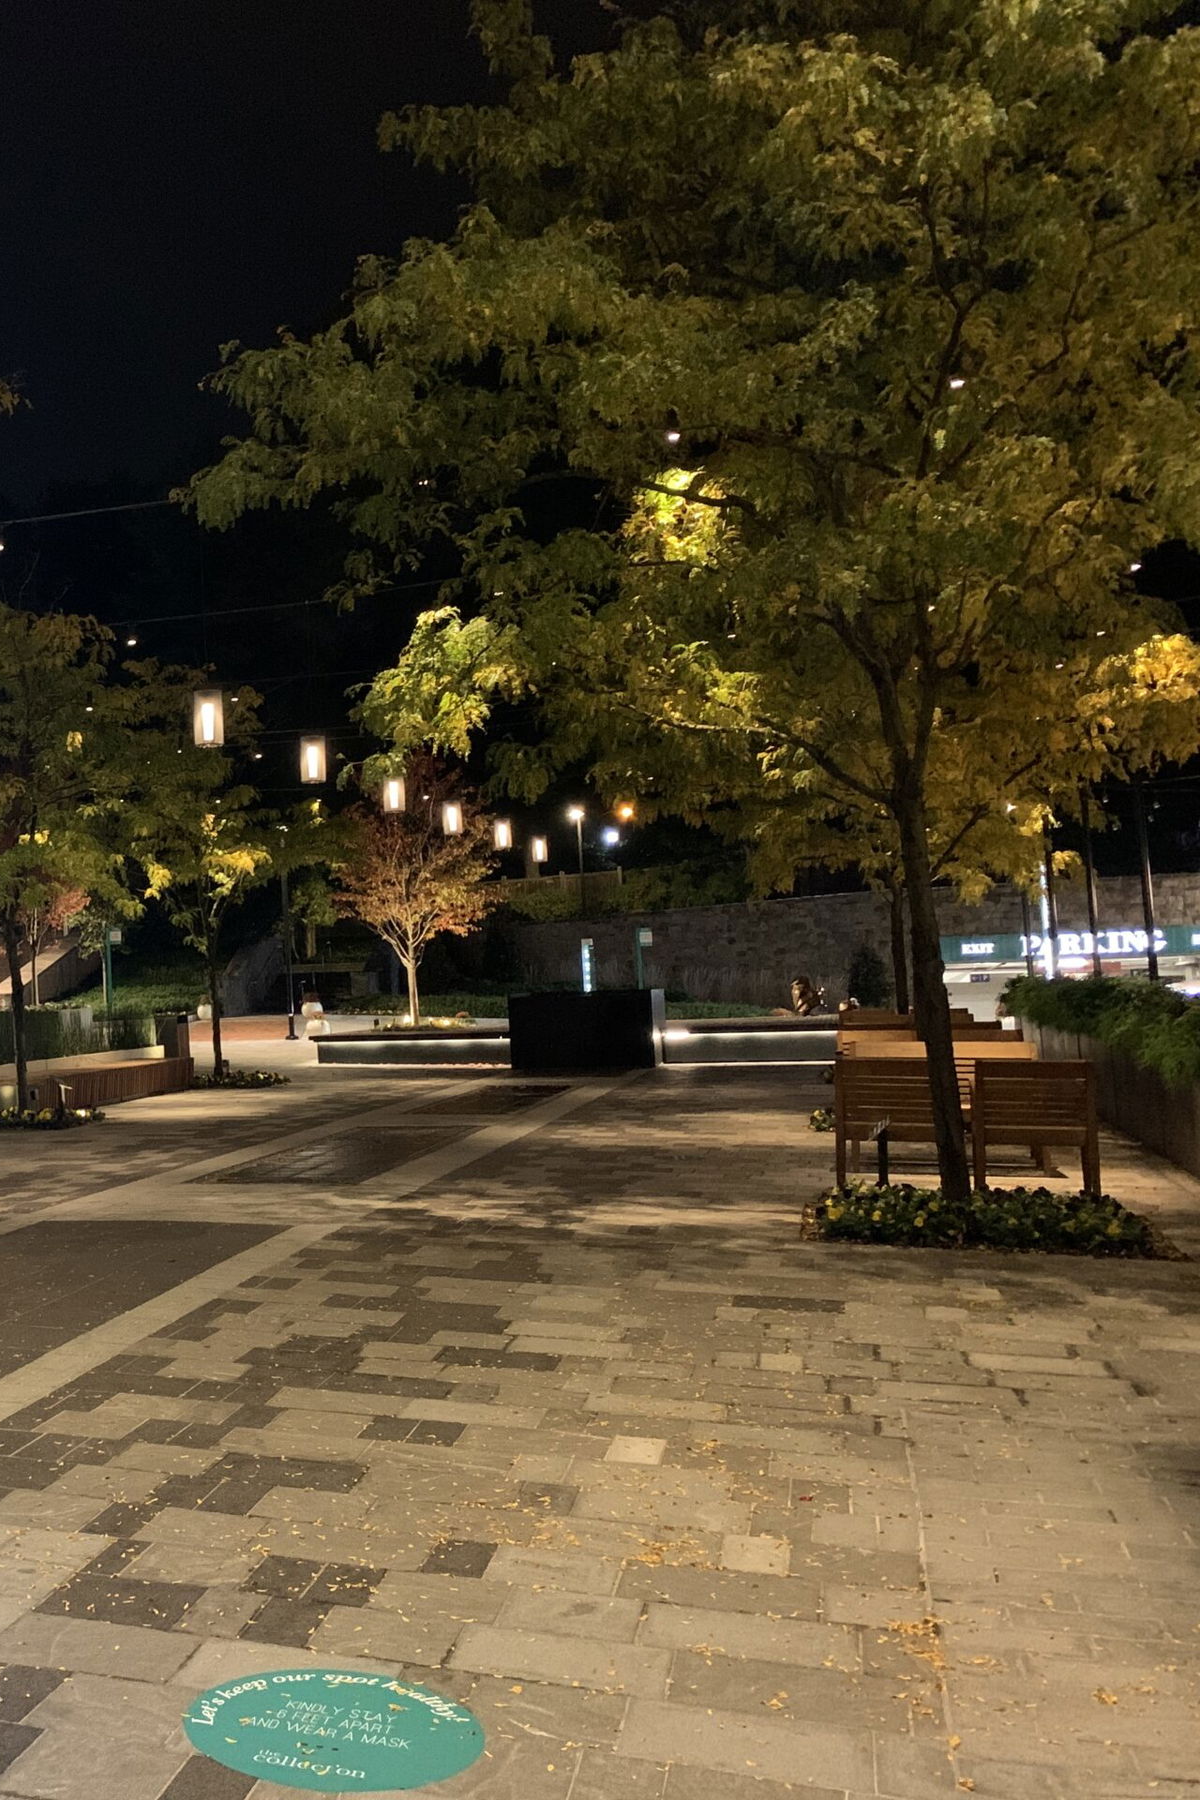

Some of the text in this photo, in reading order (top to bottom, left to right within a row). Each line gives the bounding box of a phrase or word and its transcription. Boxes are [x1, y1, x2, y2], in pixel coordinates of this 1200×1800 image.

[1019, 929, 1168, 957] PARKING
[191, 1698, 226, 1726] Let's
[215, 1678, 268, 1700] keep
[272, 1673, 316, 1684] our
[321, 1673, 380, 1686] spot
[284, 1699, 398, 1724] KINDLY STAY
[248, 1716, 413, 1750] AND WEAR A MASK
[276, 1708, 394, 1735] 6 FEET APART
